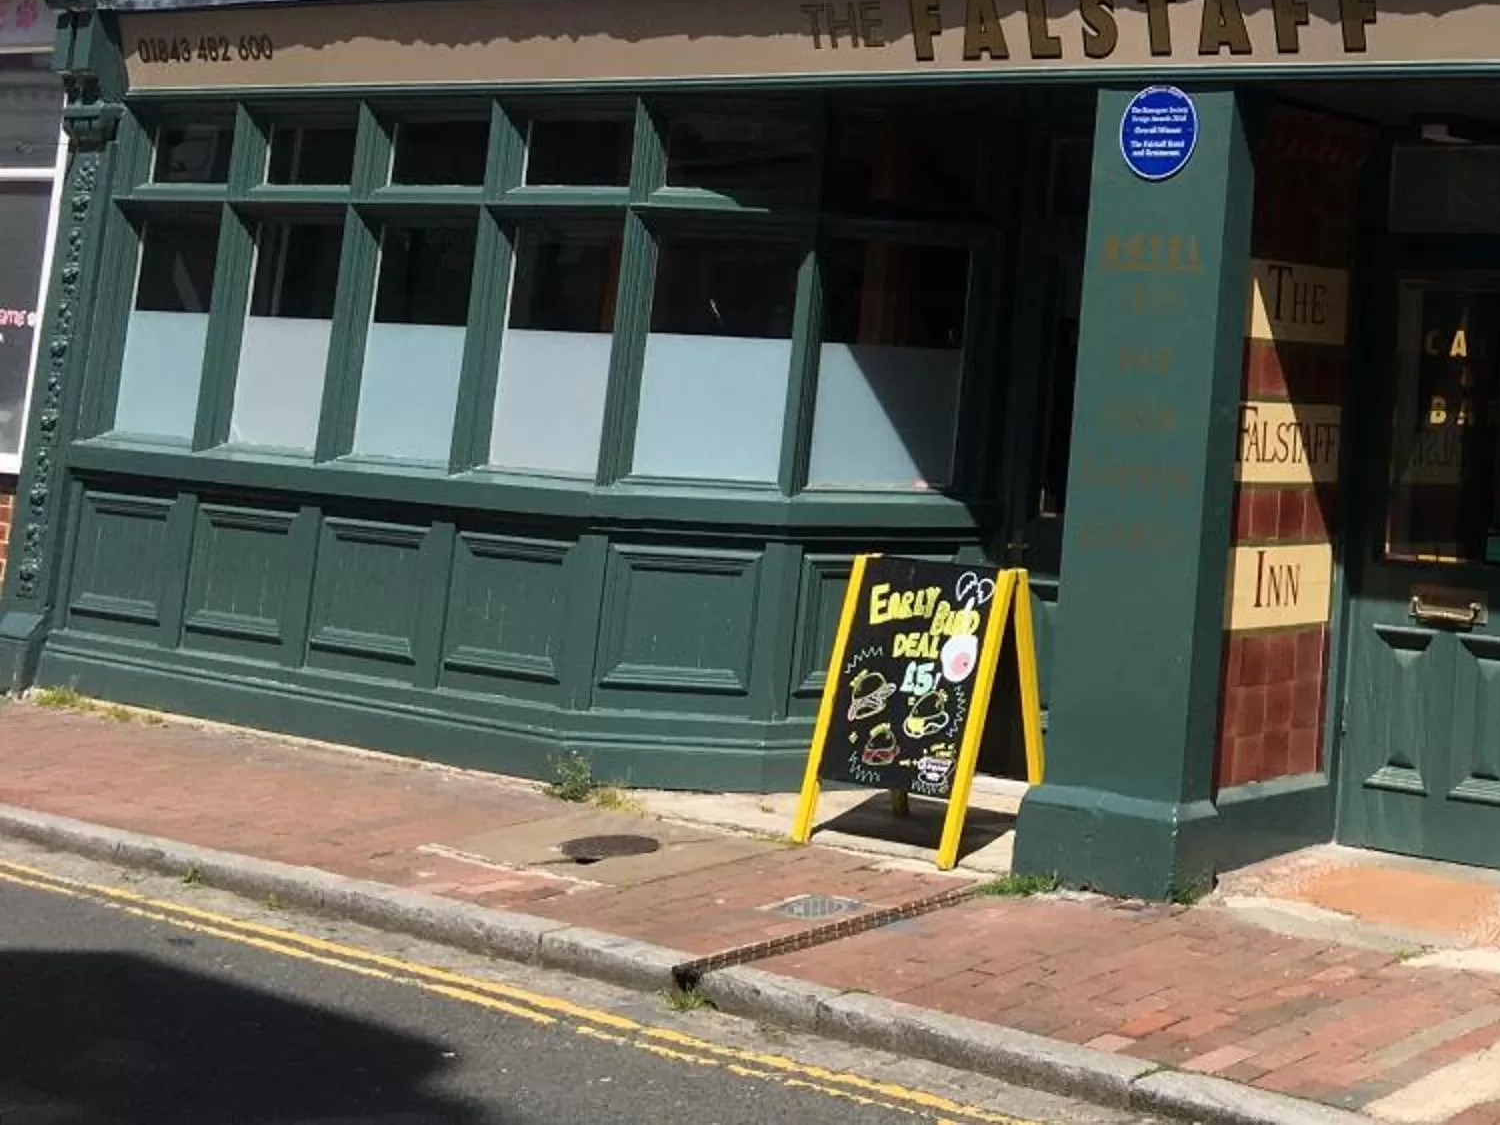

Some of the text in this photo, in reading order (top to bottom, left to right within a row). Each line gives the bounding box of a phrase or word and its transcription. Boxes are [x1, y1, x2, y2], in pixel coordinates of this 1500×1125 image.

[800, 0, 886, 50] THE
[137, 32, 273, 64] 01843 482 600
[1268, 265, 1328, 325] THE
[892, 632, 941, 660] DEAL
